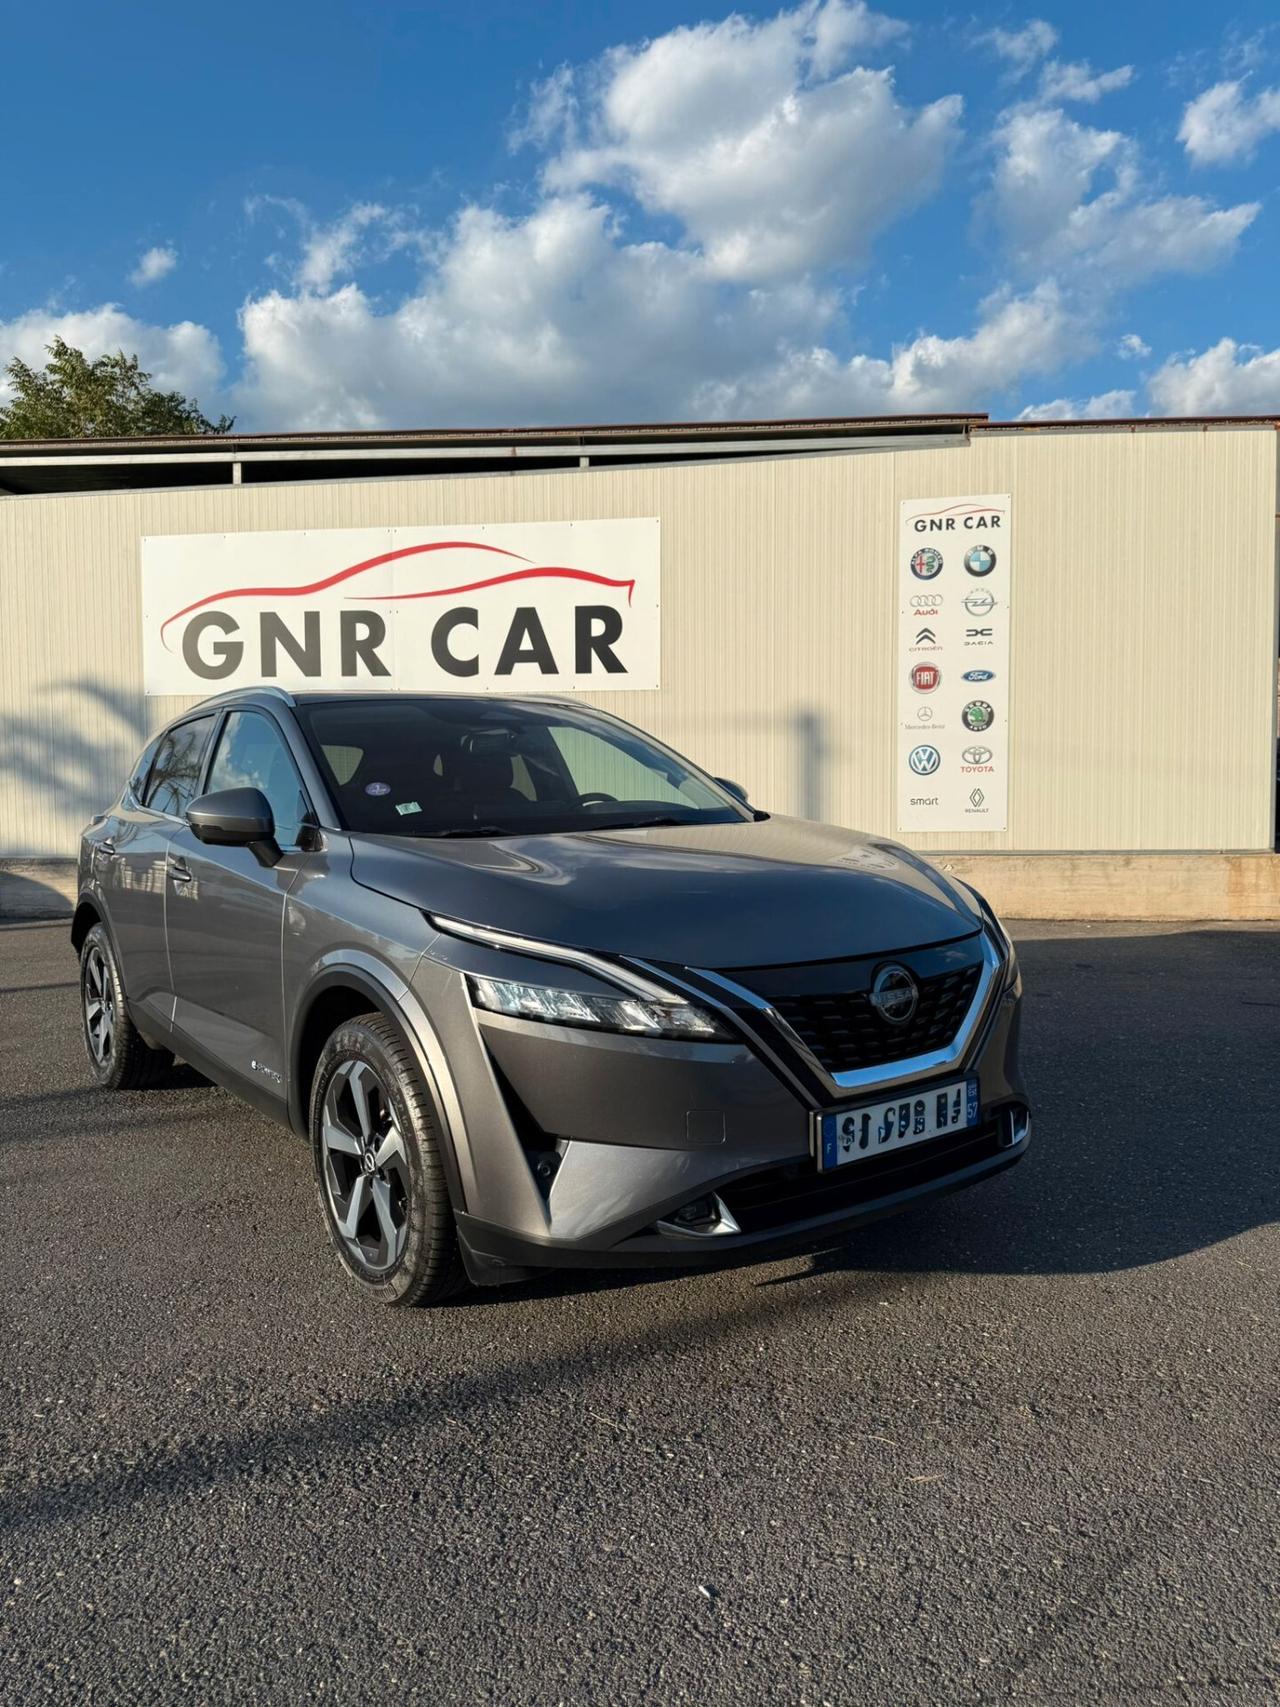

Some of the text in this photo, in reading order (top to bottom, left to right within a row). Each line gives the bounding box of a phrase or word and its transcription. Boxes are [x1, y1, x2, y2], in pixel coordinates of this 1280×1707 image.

[914, 515, 1001, 532] GNR CAR
[913, 608, 939, 616] Audi
[181, 605, 628, 680] GNR CAR
[916, 671, 935, 686] FIAT
[968, 672, 988, 681] Ford
[960, 766, 994, 774] TOYOTA
[910, 797, 939, 806] smart
[967, 1101, 978, 1119] 57
[826, 1142, 832, 1154] F
